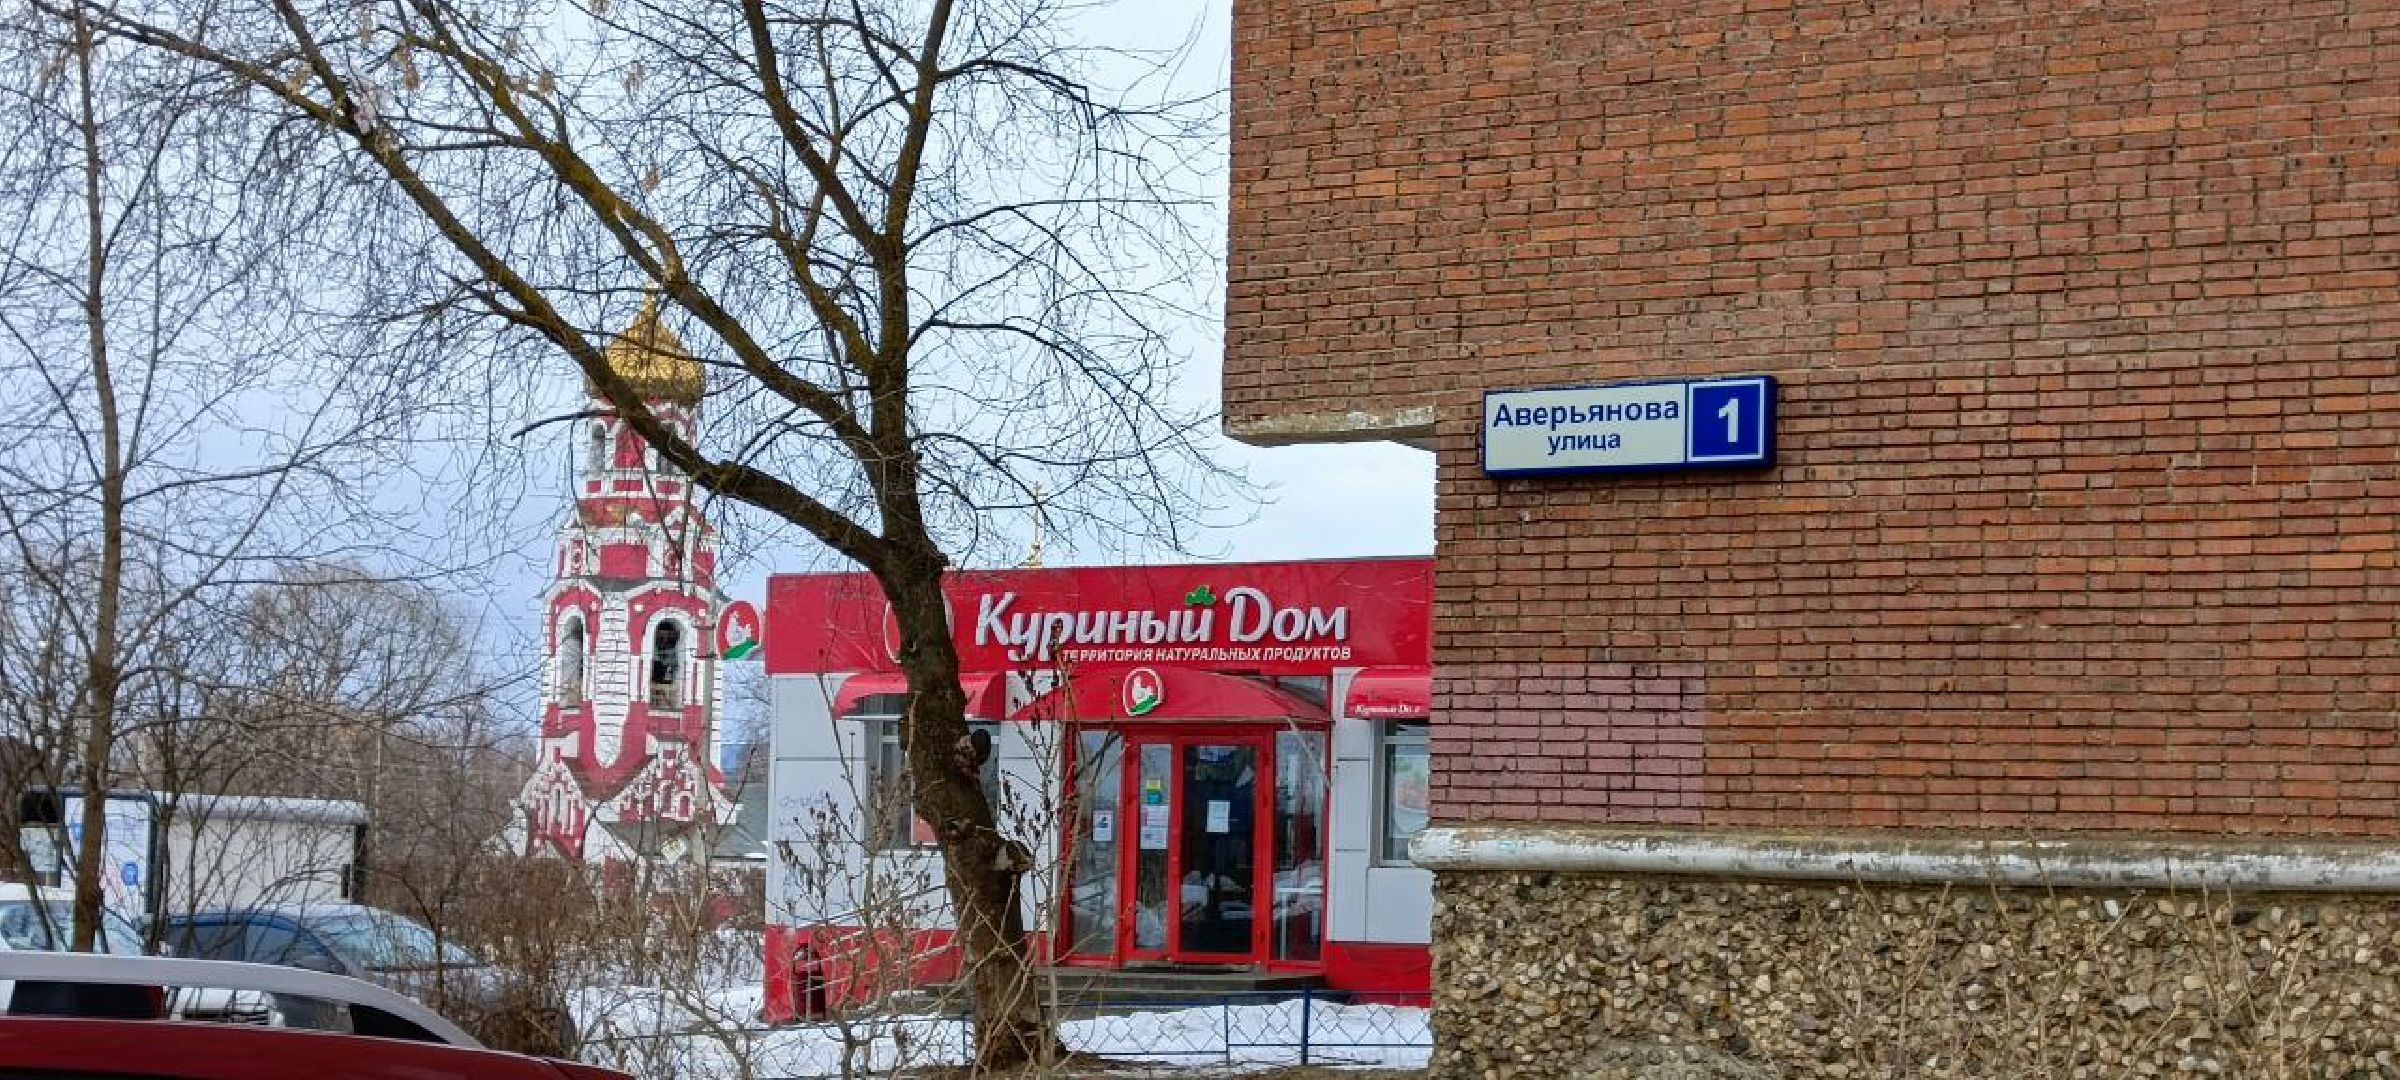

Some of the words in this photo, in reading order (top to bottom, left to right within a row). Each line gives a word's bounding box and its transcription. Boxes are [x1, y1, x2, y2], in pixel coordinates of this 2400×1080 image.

[1493, 400, 1680, 431] Аверьянова
[1718, 398, 1740, 443] 1
[1547, 432, 1621, 455] улица
[975, 588, 1216, 662] Куриный
[1225, 586, 1348, 643] Дом
[1062, 649, 1153, 662] ТЕРРИТОРИЯ
[1155, 647, 1261, 661] НАТУРАЛЬНЫХ
[1262, 646, 1352, 663] ПРОДУКТОВ
